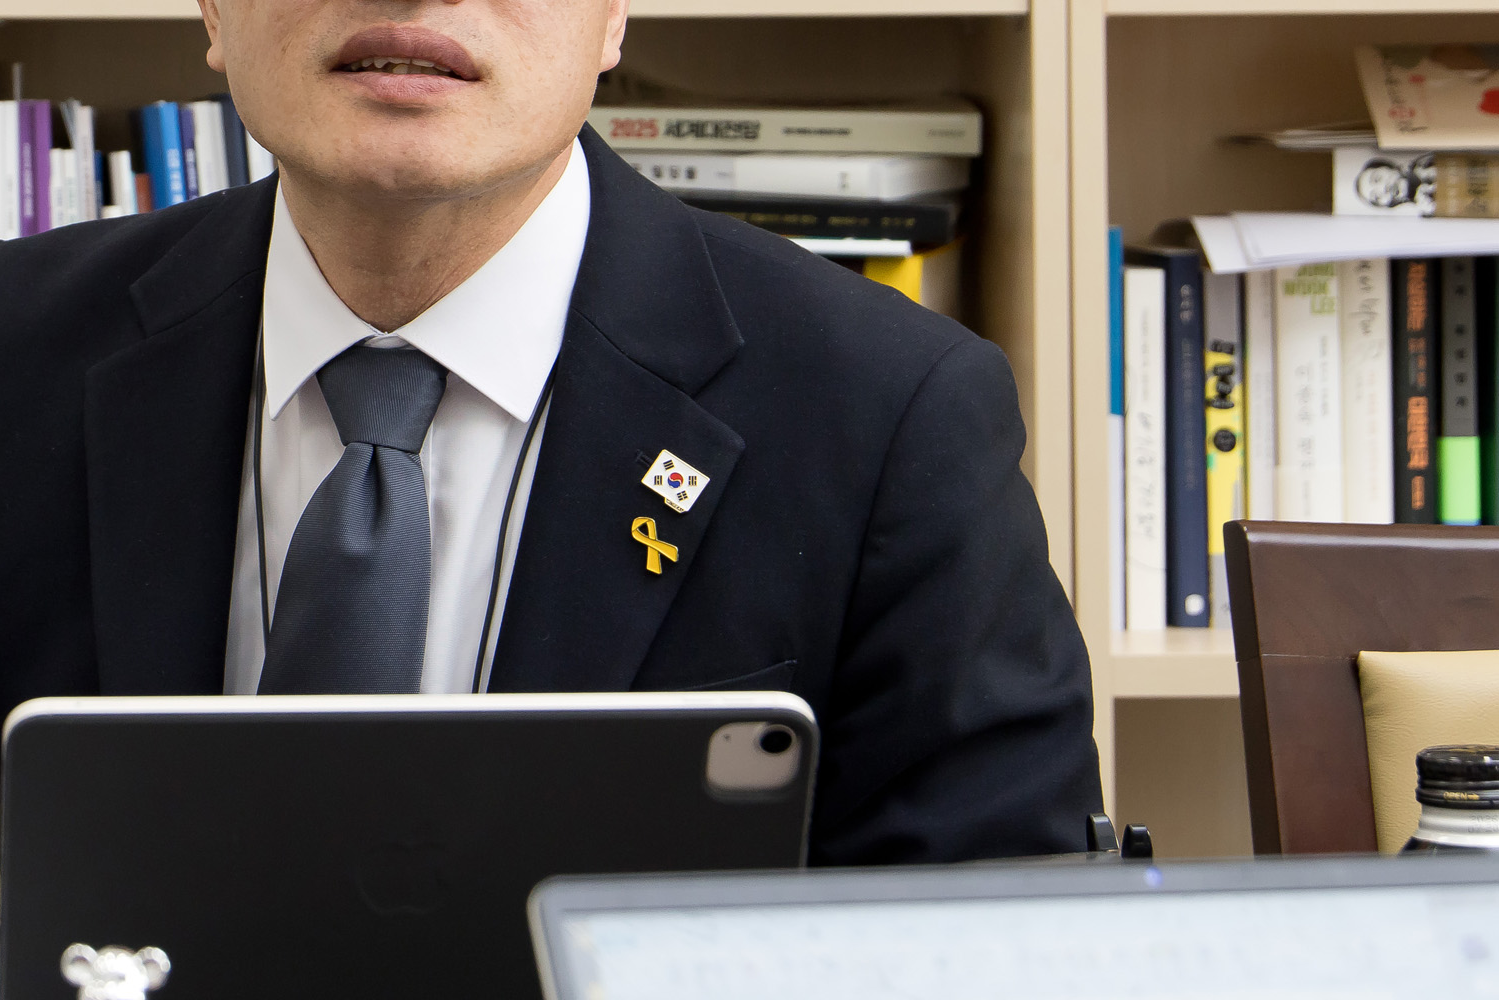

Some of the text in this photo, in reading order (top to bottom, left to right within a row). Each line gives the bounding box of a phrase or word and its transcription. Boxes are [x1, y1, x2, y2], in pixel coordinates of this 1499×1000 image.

[609, 118, 659, 139] 2025
[663, 119, 761, 140] 세계대전망
[1443, 791, 1468, 800] OPEN
